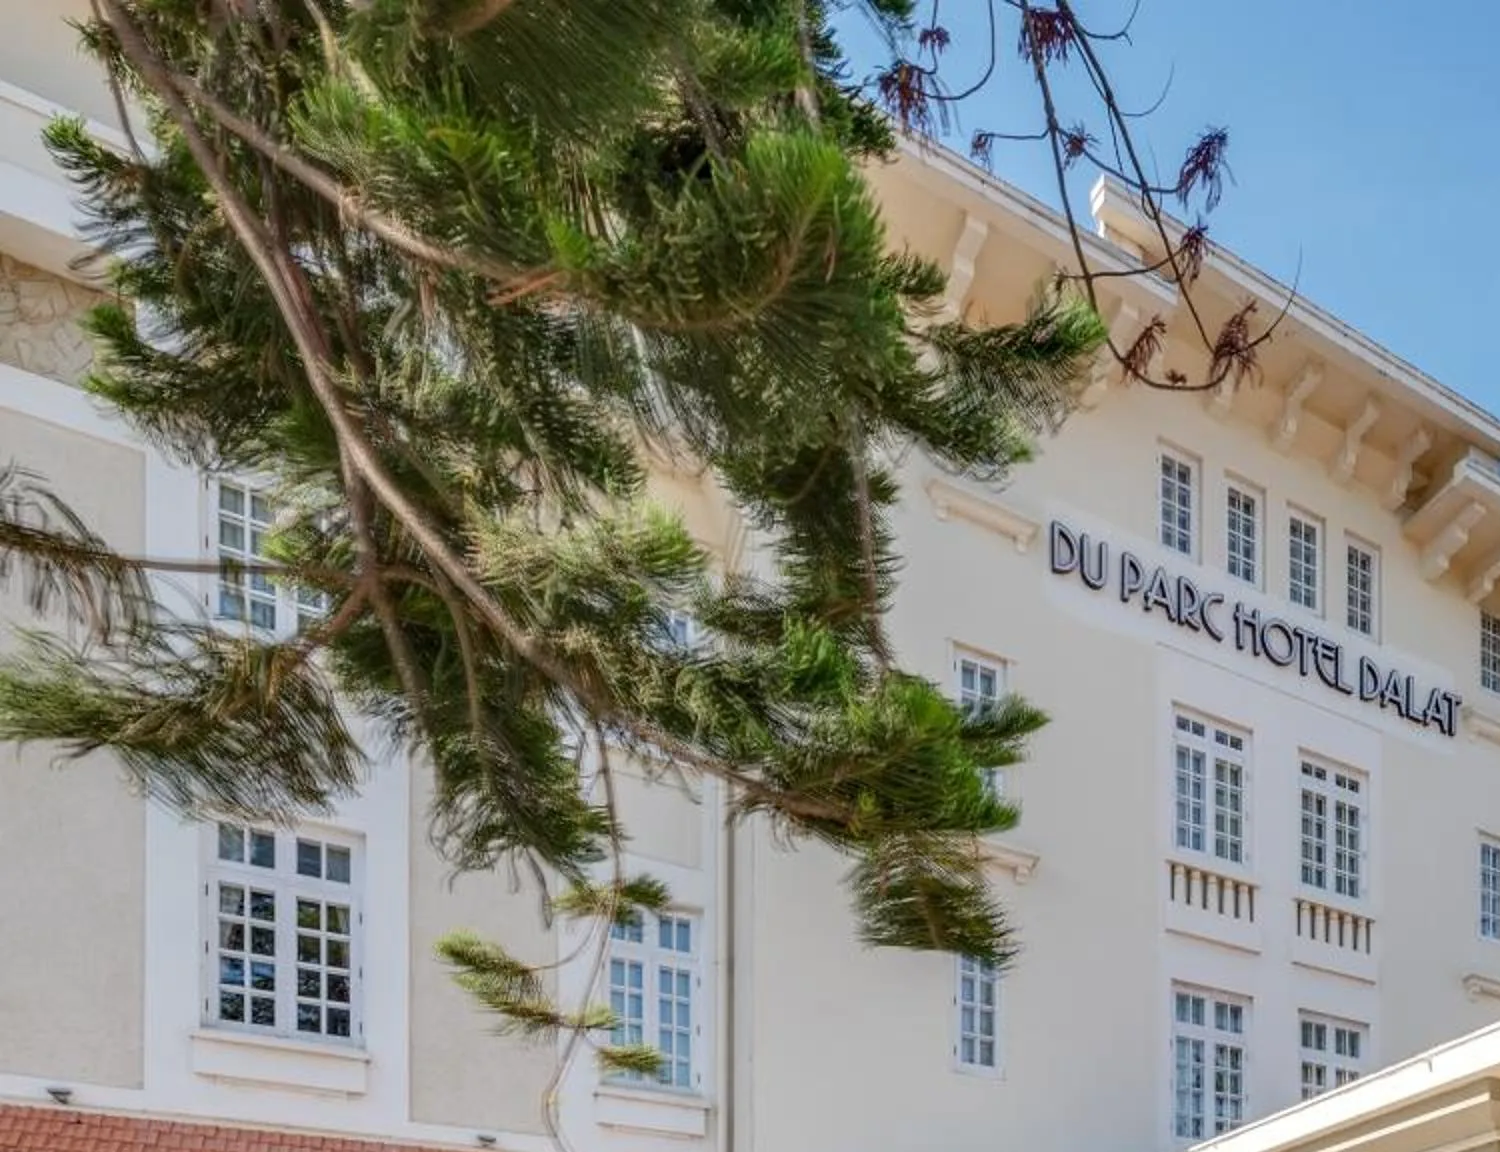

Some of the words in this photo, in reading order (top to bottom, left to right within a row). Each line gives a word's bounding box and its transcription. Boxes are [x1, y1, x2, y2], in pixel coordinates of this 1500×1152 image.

[1050, 520, 1108, 590] DU
[1121, 551, 1225, 642] PARC
[1232, 602, 1353, 695] HOTEL
[1360, 655, 1462, 737] DALAT
